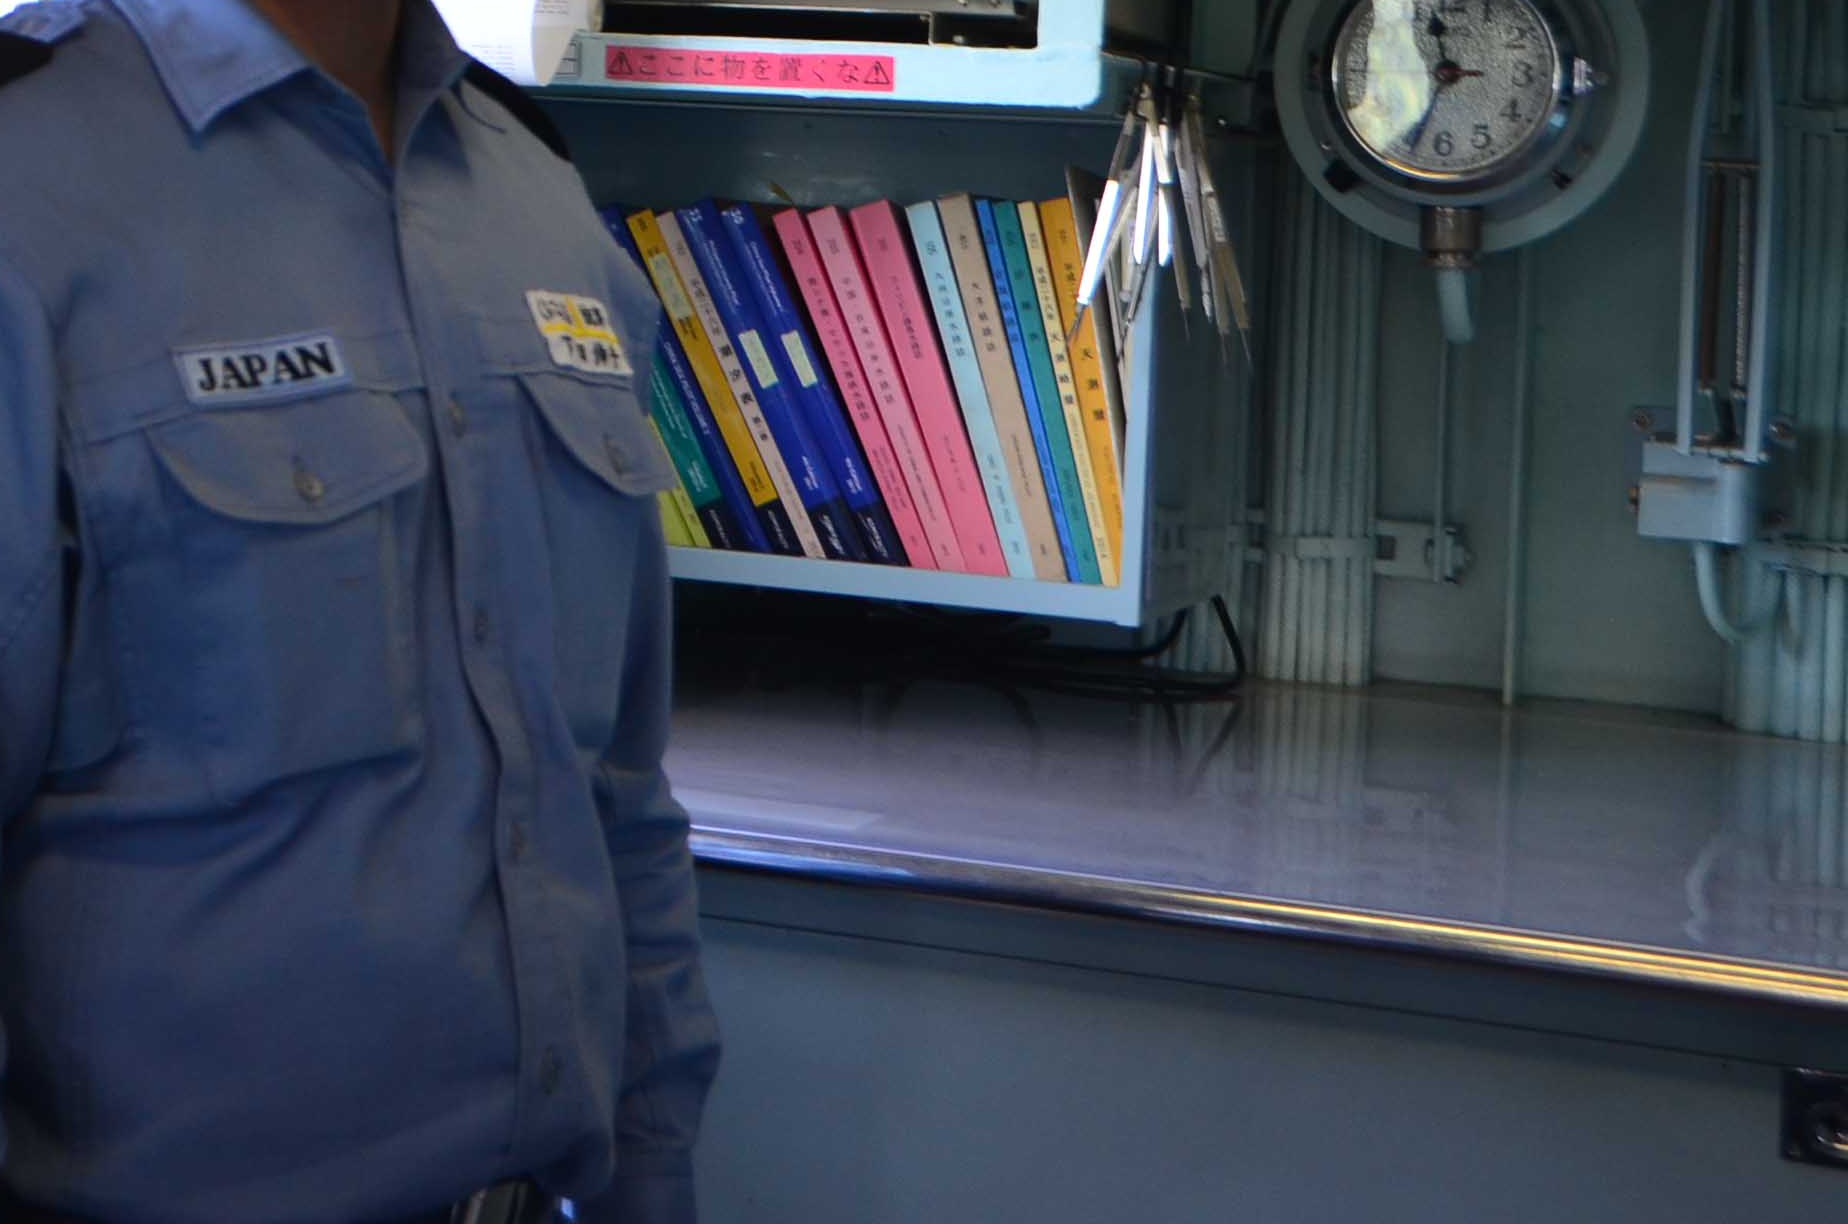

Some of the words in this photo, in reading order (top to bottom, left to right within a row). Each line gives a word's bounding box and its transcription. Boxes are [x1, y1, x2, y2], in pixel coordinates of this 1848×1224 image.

[1504, 26, 1527, 50] 2
[638, 54, 863, 85] ここに物を置くな
[1511, 60, 1534, 87] 3
[1499, 97, 1522, 123] 4
[1433, 130, 1454, 157] 6
[1470, 124, 1493, 150] 5
[195, 340, 336, 392] JAPAN
